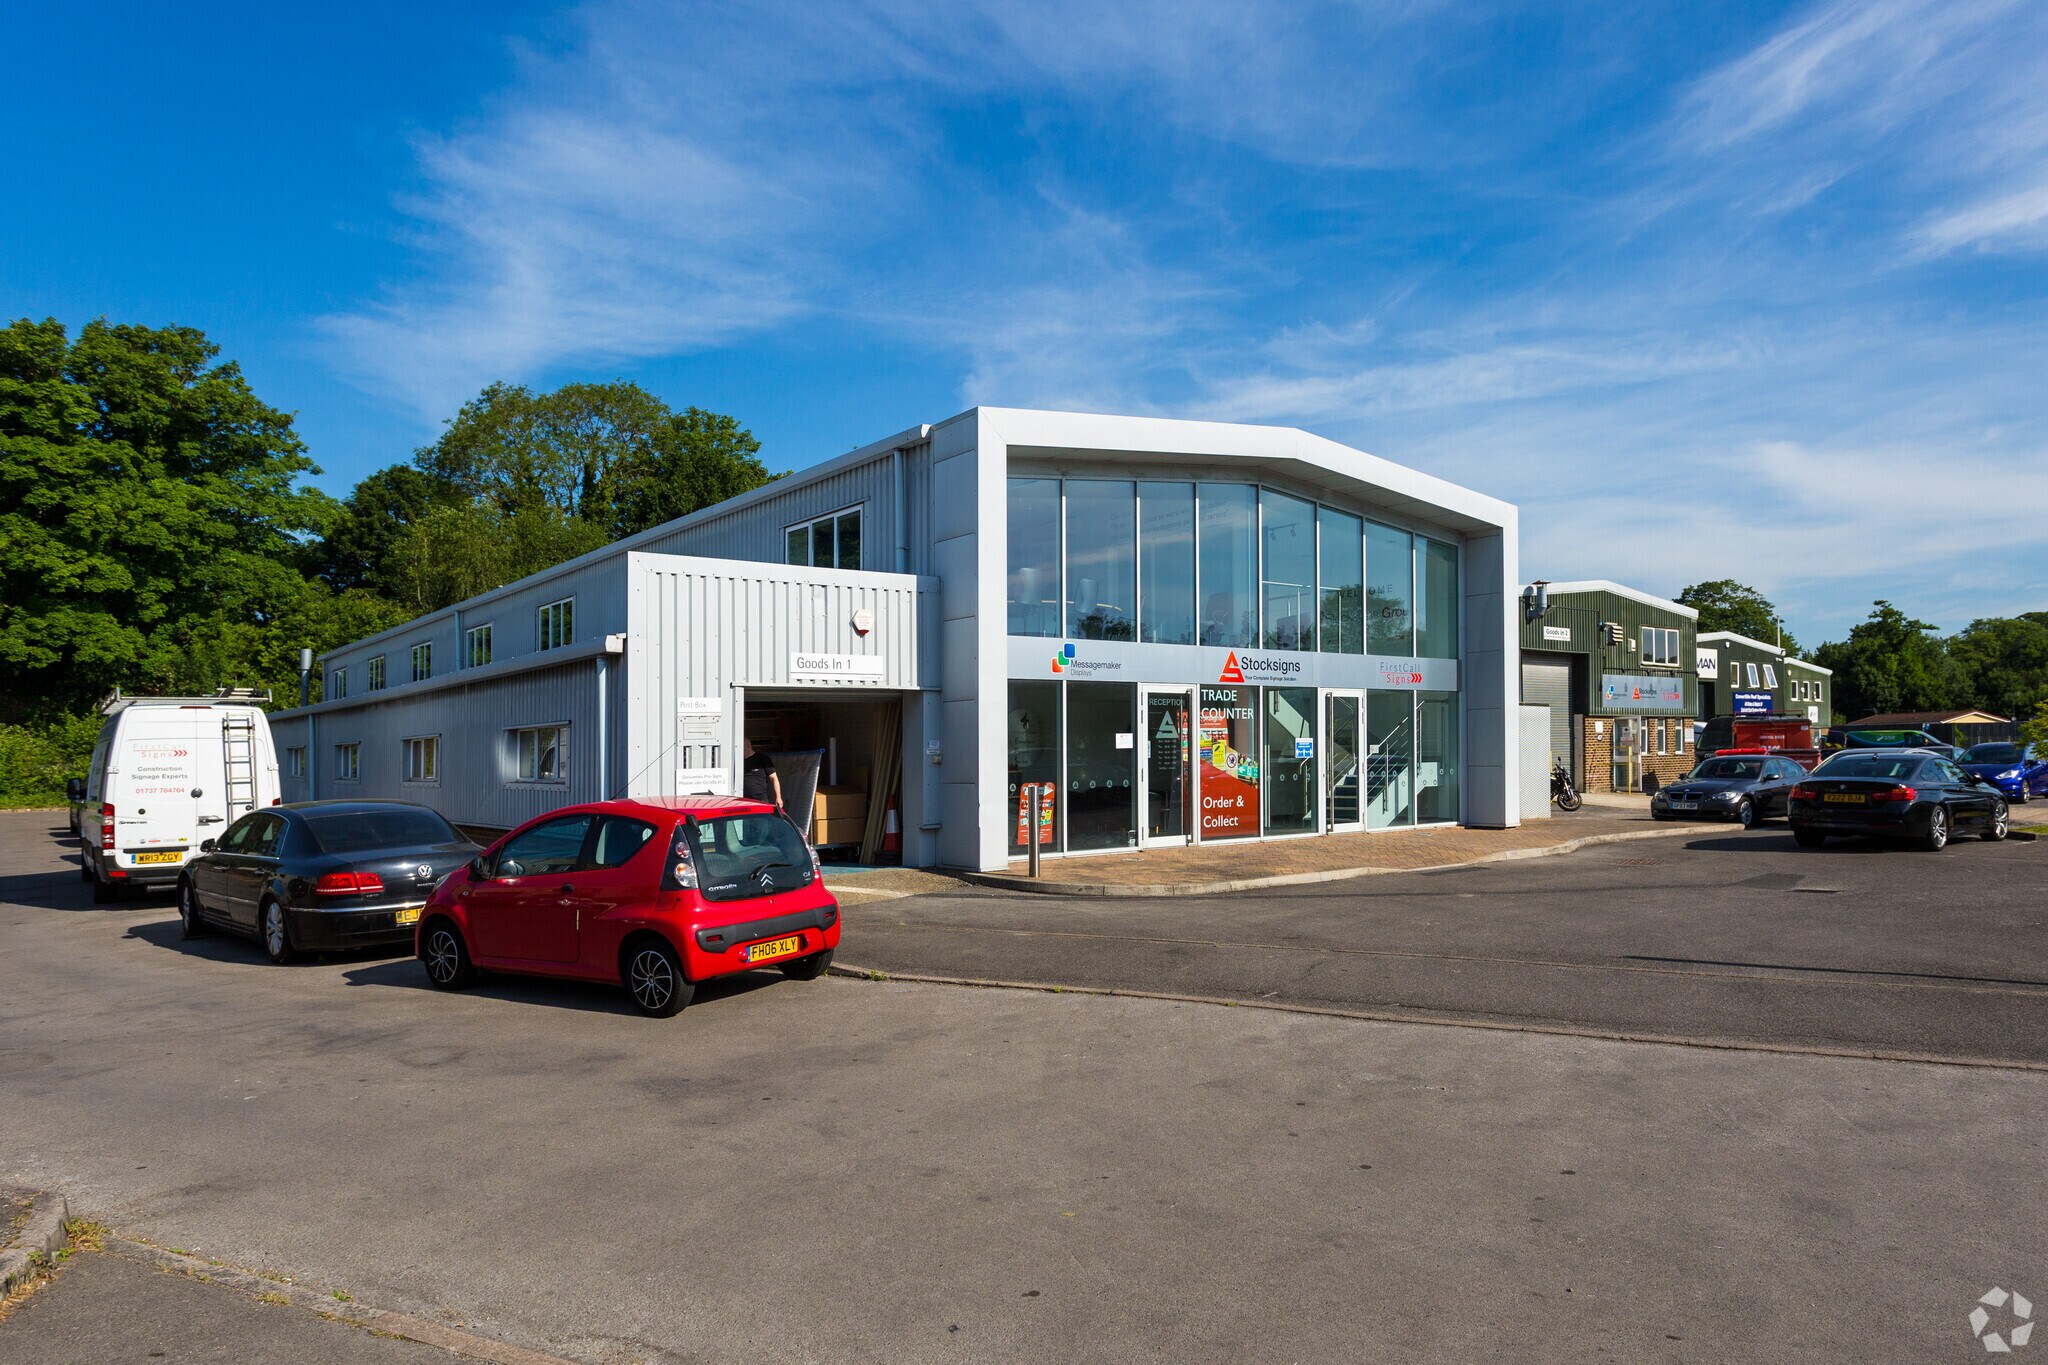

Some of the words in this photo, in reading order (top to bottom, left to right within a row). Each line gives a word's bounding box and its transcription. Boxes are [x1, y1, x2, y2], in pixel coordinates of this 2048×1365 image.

[1337, 584, 1393, 599] WELOME
[796, 656, 829, 669] Goods
[832, 658, 842, 669] In
[847, 659, 851, 669] 1
[1071, 660, 1121, 670] Messagemaker
[1241, 656, 1301, 675] Stocksigns
[1380, 662, 1420, 672] FirstCall
[1071, 669, 1092, 677] Displays
[1386, 673, 1411, 685] Signs
[1201, 689, 1238, 701] TRADE
[1149, 698, 1185, 706] RECEPTION
[1201, 707, 1254, 719] COUNTER
[1203, 796, 1234, 809] Order
[1236, 795, 1244, 807] &
[1203, 815, 1239, 828] Collect
[138, 854, 159, 862] WR13
[161, 853, 179, 861] ZGY
[752, 942, 777, 959] FH06
[779, 938, 797, 953] XLY
